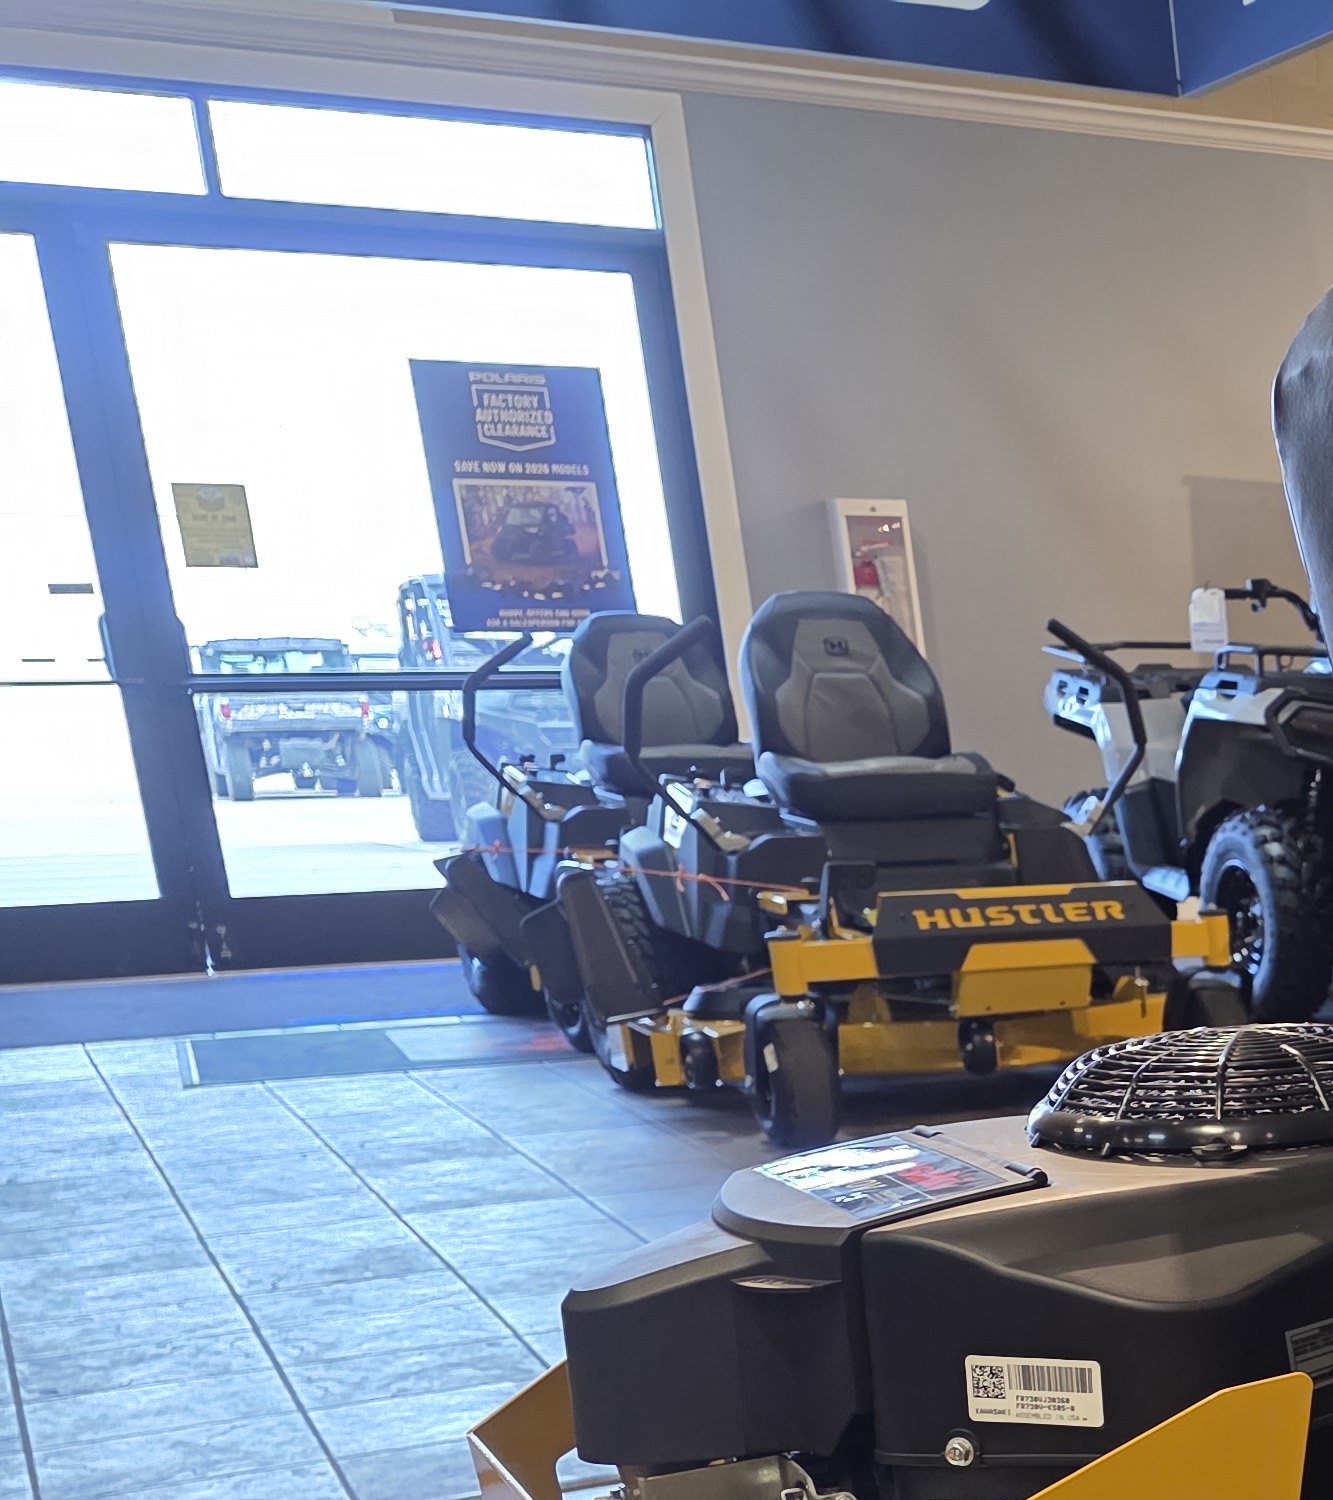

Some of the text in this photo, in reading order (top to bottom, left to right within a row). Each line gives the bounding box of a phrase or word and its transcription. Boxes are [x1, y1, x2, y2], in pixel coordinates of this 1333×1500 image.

[468, 371, 546, 385] POLARIS
[482, 393, 539, 409] FACTORY
[475, 409, 553, 424] AUTHORIZED
[483, 424, 549, 438] CLEARANCE
[454, 460, 481, 473] SAVE
[482, 461, 506, 474] NOW
[912, 900, 1125, 930] HUSTLER
[975, 1407, 1011, 1416] KAWASAKI
